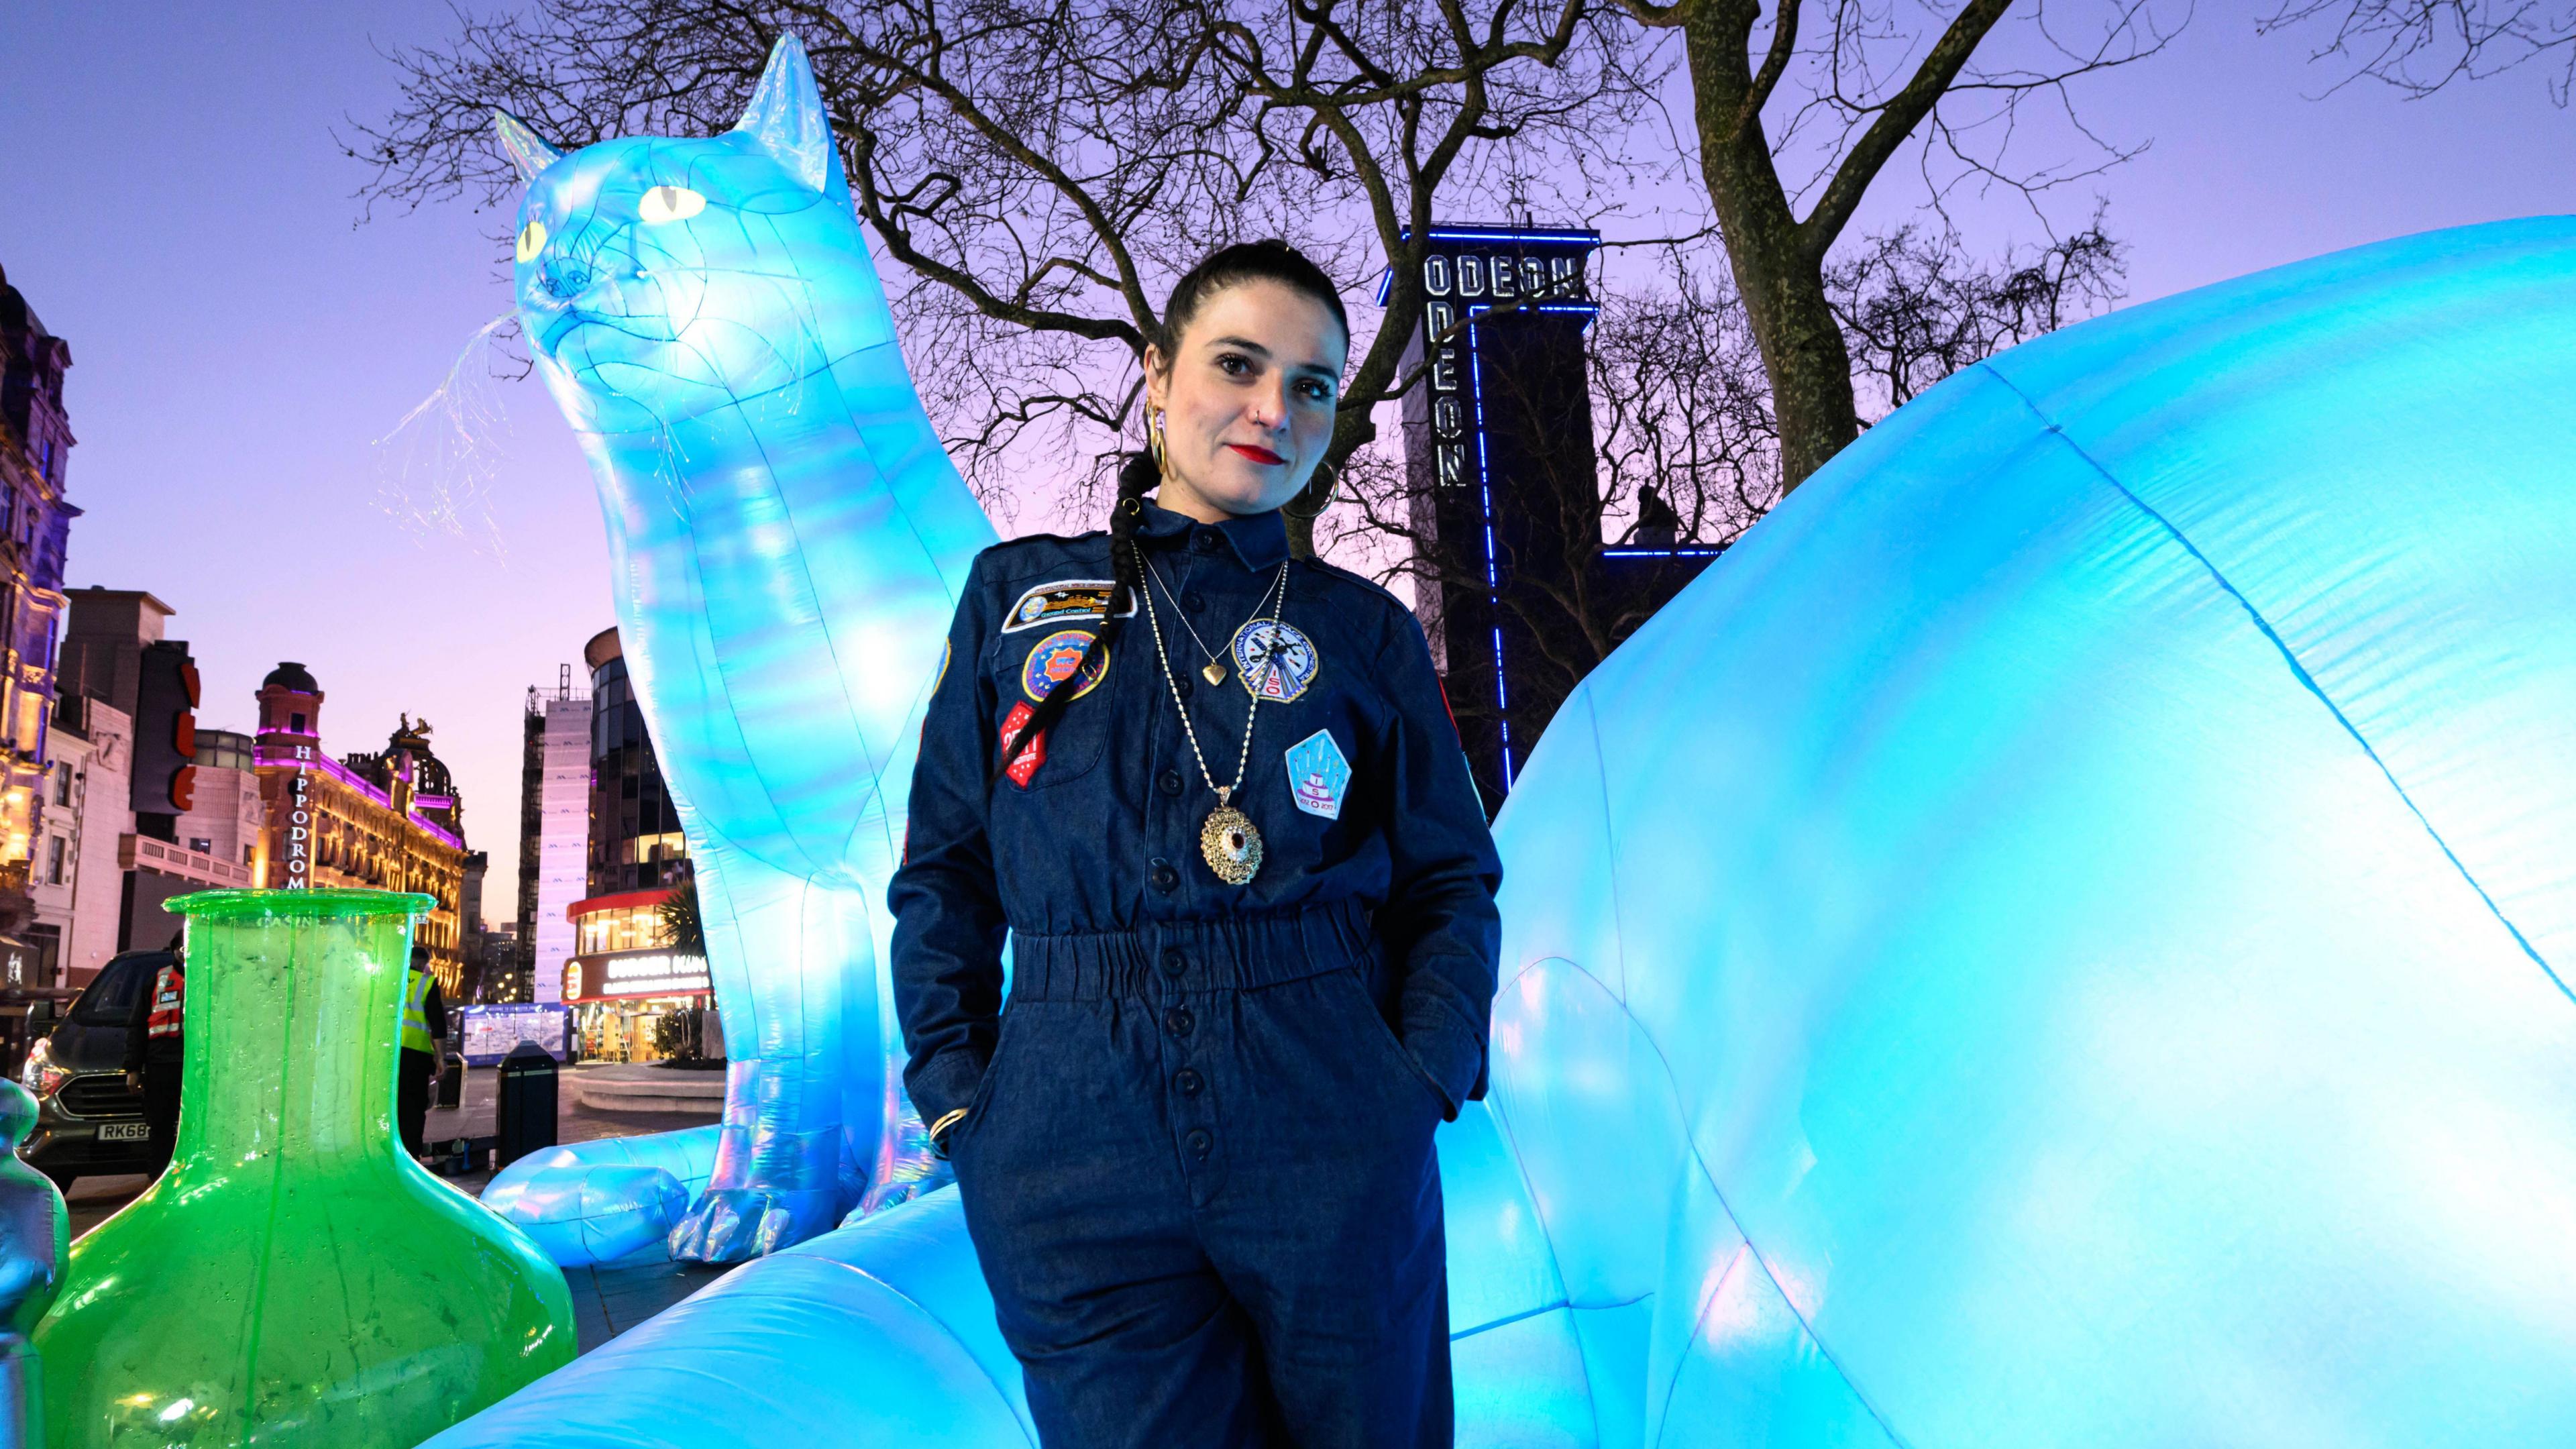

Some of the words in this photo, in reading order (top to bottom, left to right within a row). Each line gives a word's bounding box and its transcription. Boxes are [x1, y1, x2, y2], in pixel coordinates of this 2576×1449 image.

[1424, 255, 1578, 298] ODEON
[1040, 610, 1065, 618] Ground
[1236, 621, 1270, 669] INTERNATIONAL
[1266, 669, 1280, 695] ISO
[286, 745, 311, 889] HIPPODROM
[256, 916, 313, 927] CASIN
[105, 1124, 146, 1138] RK68
